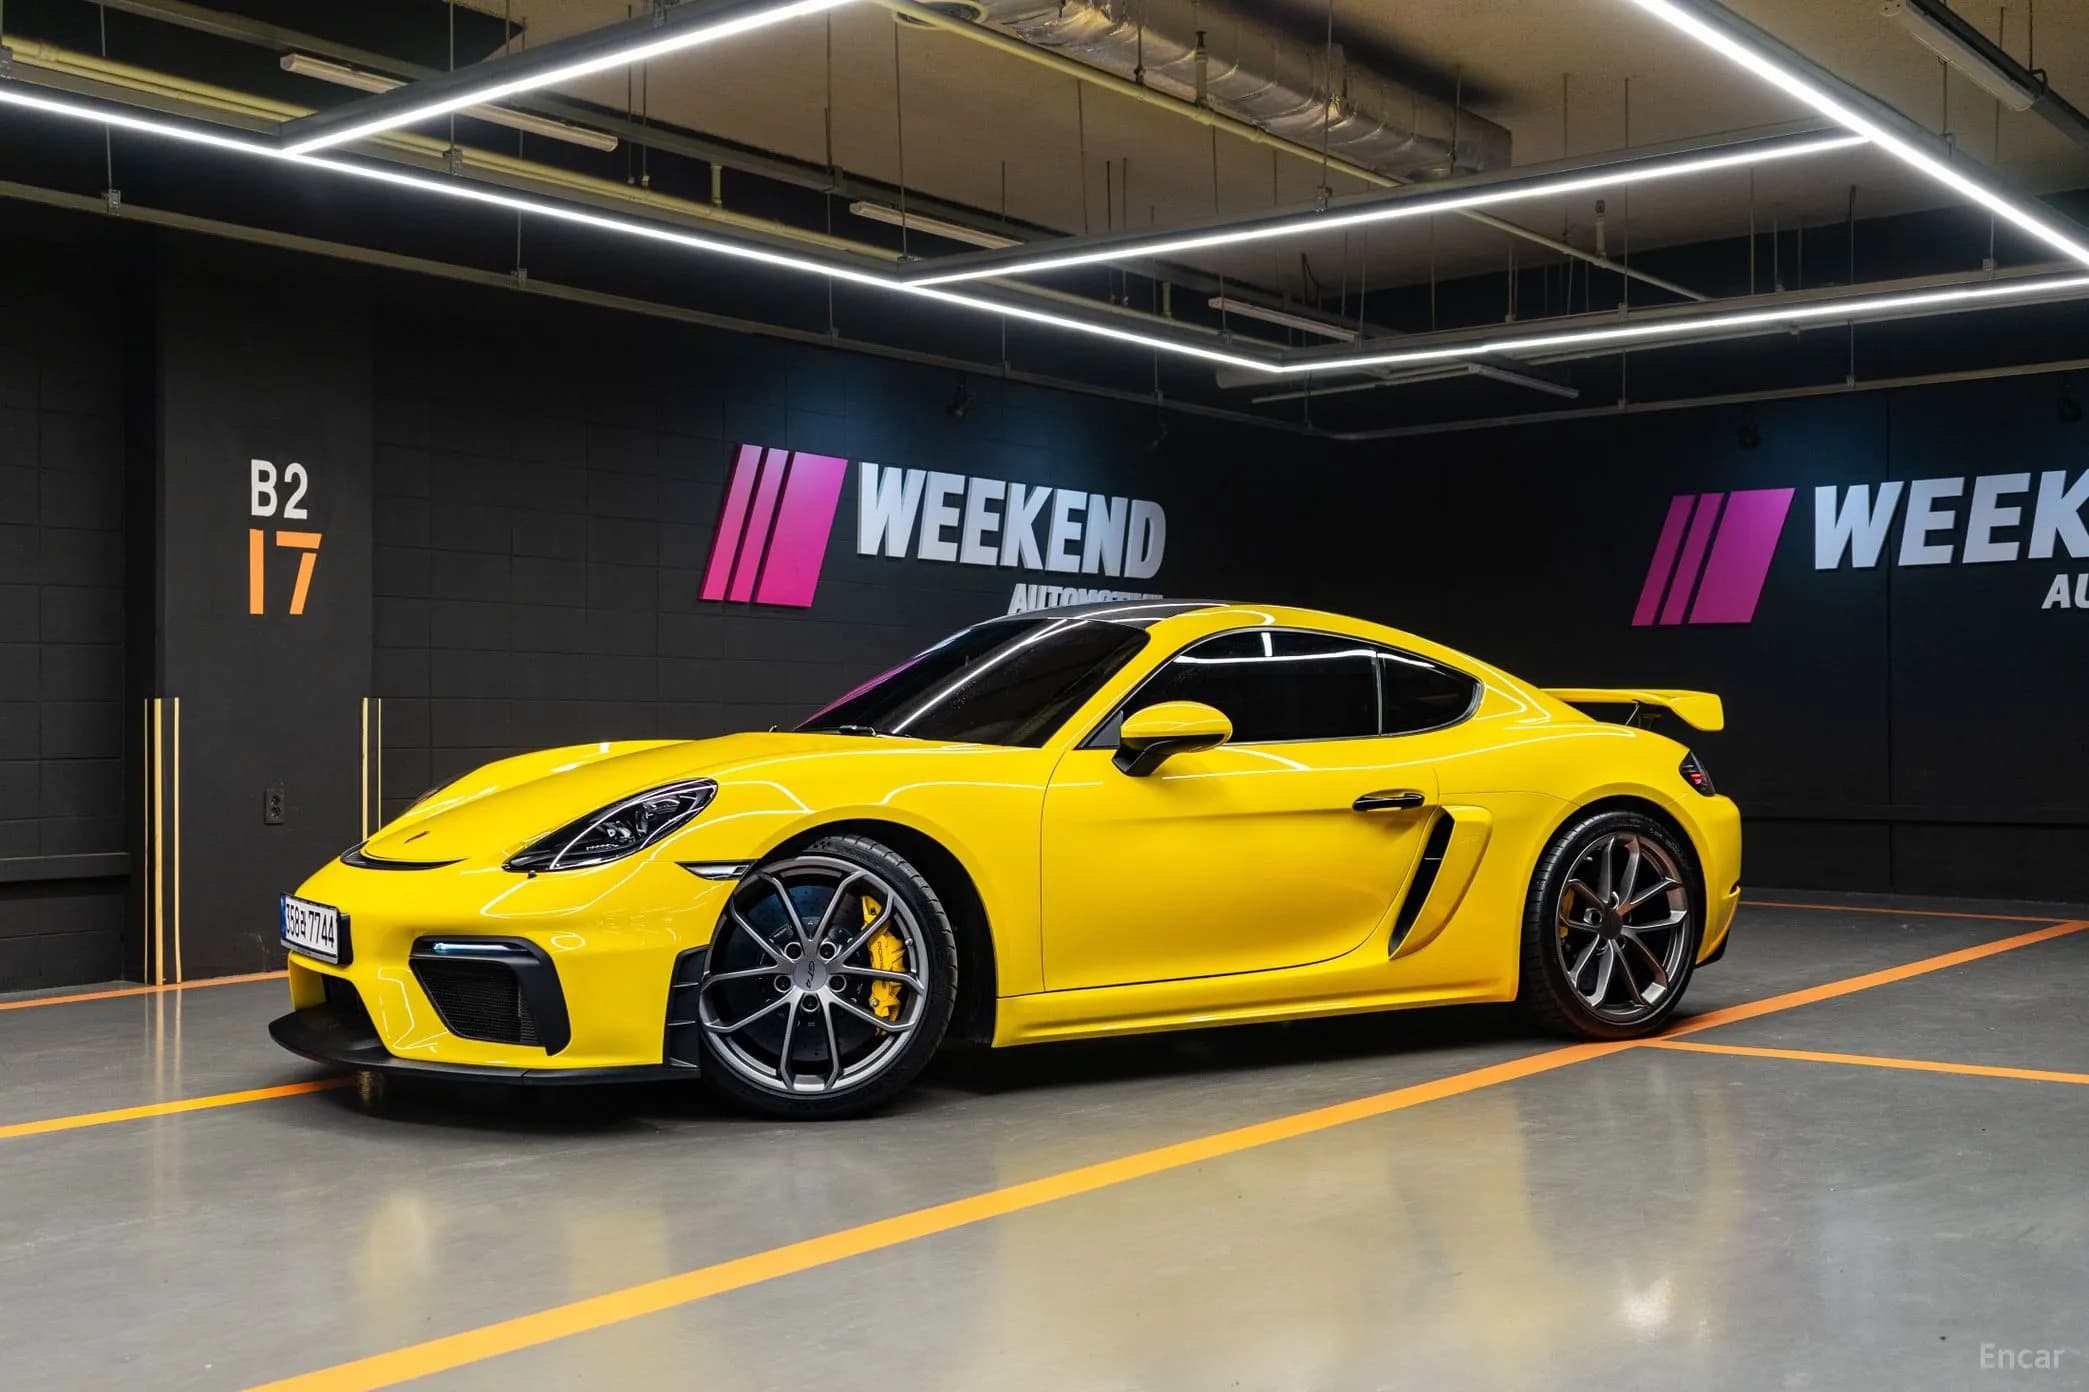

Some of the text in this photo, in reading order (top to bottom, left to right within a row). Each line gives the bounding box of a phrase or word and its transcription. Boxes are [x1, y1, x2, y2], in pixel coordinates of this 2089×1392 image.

[251, 459, 308, 520] B2
[857, 461, 1167, 579] WEEKEND
[249, 528, 323, 615] 17
